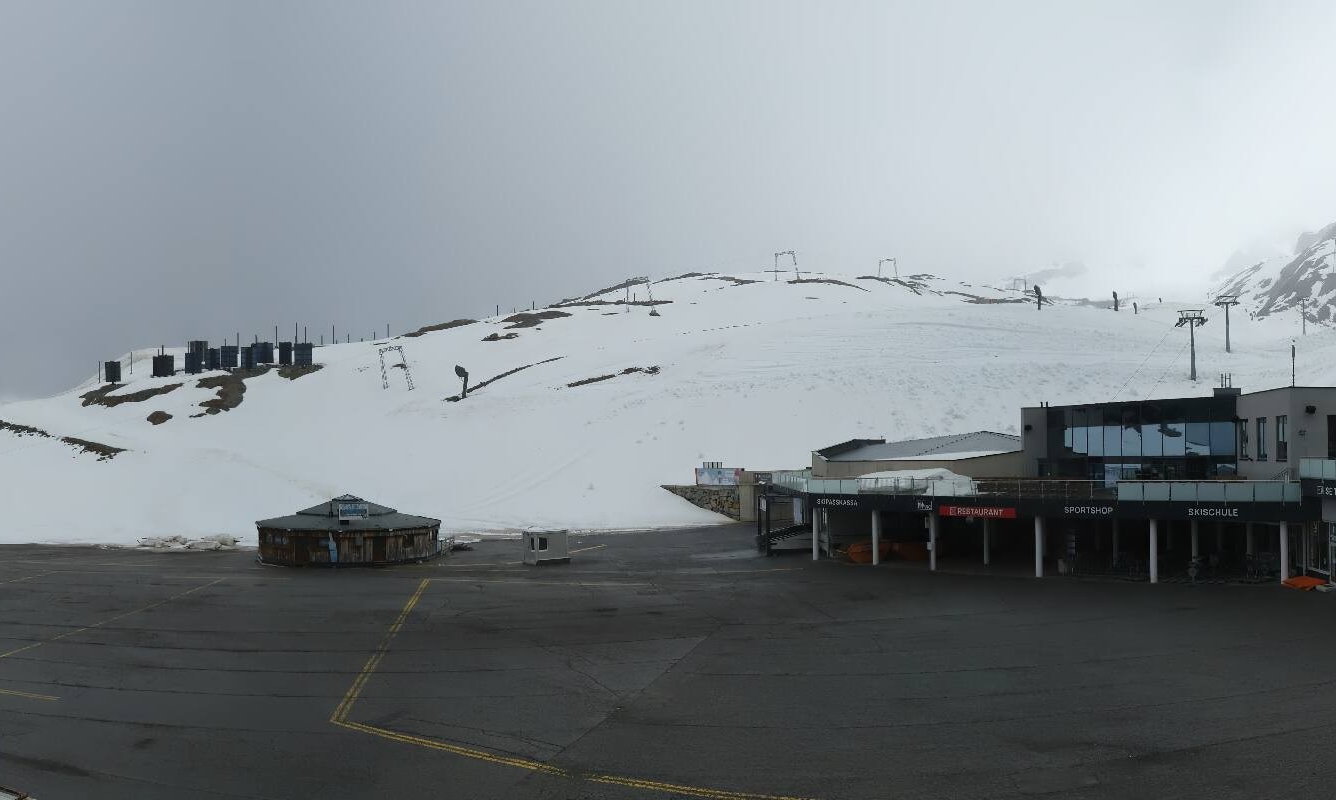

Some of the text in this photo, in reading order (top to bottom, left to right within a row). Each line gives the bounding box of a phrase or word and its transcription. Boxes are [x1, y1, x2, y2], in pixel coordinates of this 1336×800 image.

[957, 507, 1004, 517] RESTAURANT
[1064, 506, 1114, 515] SPORTSHOP
[1188, 508, 1239, 517] SKISCHULE
